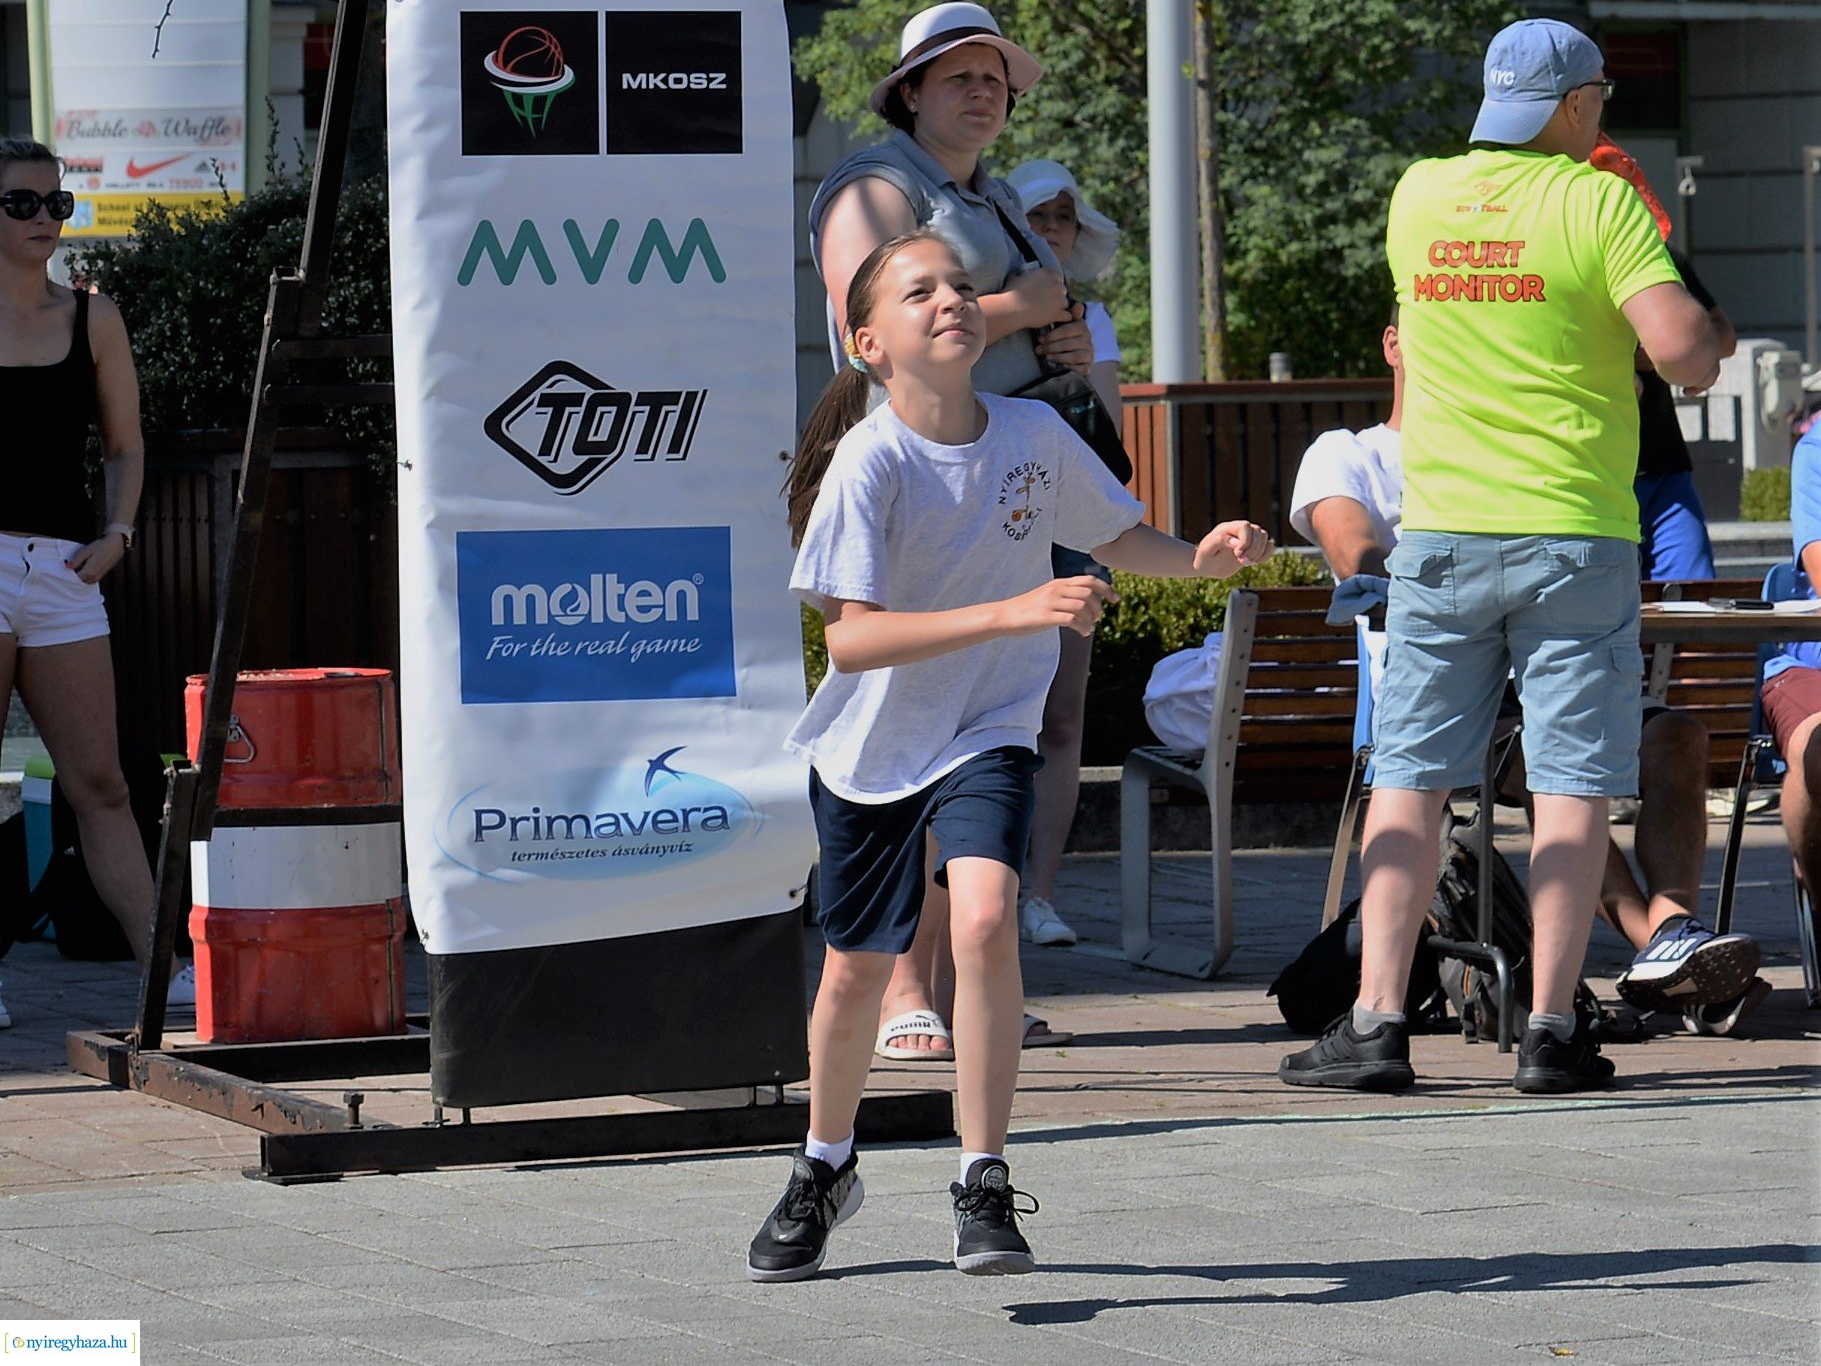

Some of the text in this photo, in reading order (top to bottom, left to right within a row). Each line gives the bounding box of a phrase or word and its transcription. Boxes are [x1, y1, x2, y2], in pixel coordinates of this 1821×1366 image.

[621, 72, 727, 90] MKOSZ
[1490, 68, 1515, 85] NYC
[457, 218, 726, 286] MVM
[1428, 240, 1525, 268] COURT
[1414, 274, 1546, 302] MONITOR
[535, 389, 708, 462] TOTI
[491, 574, 699, 625] molten
[486, 631, 702, 663] For the real game
[473, 805, 731, 842] Primavera
[511, 840, 694, 862] természetes ásványvíz
